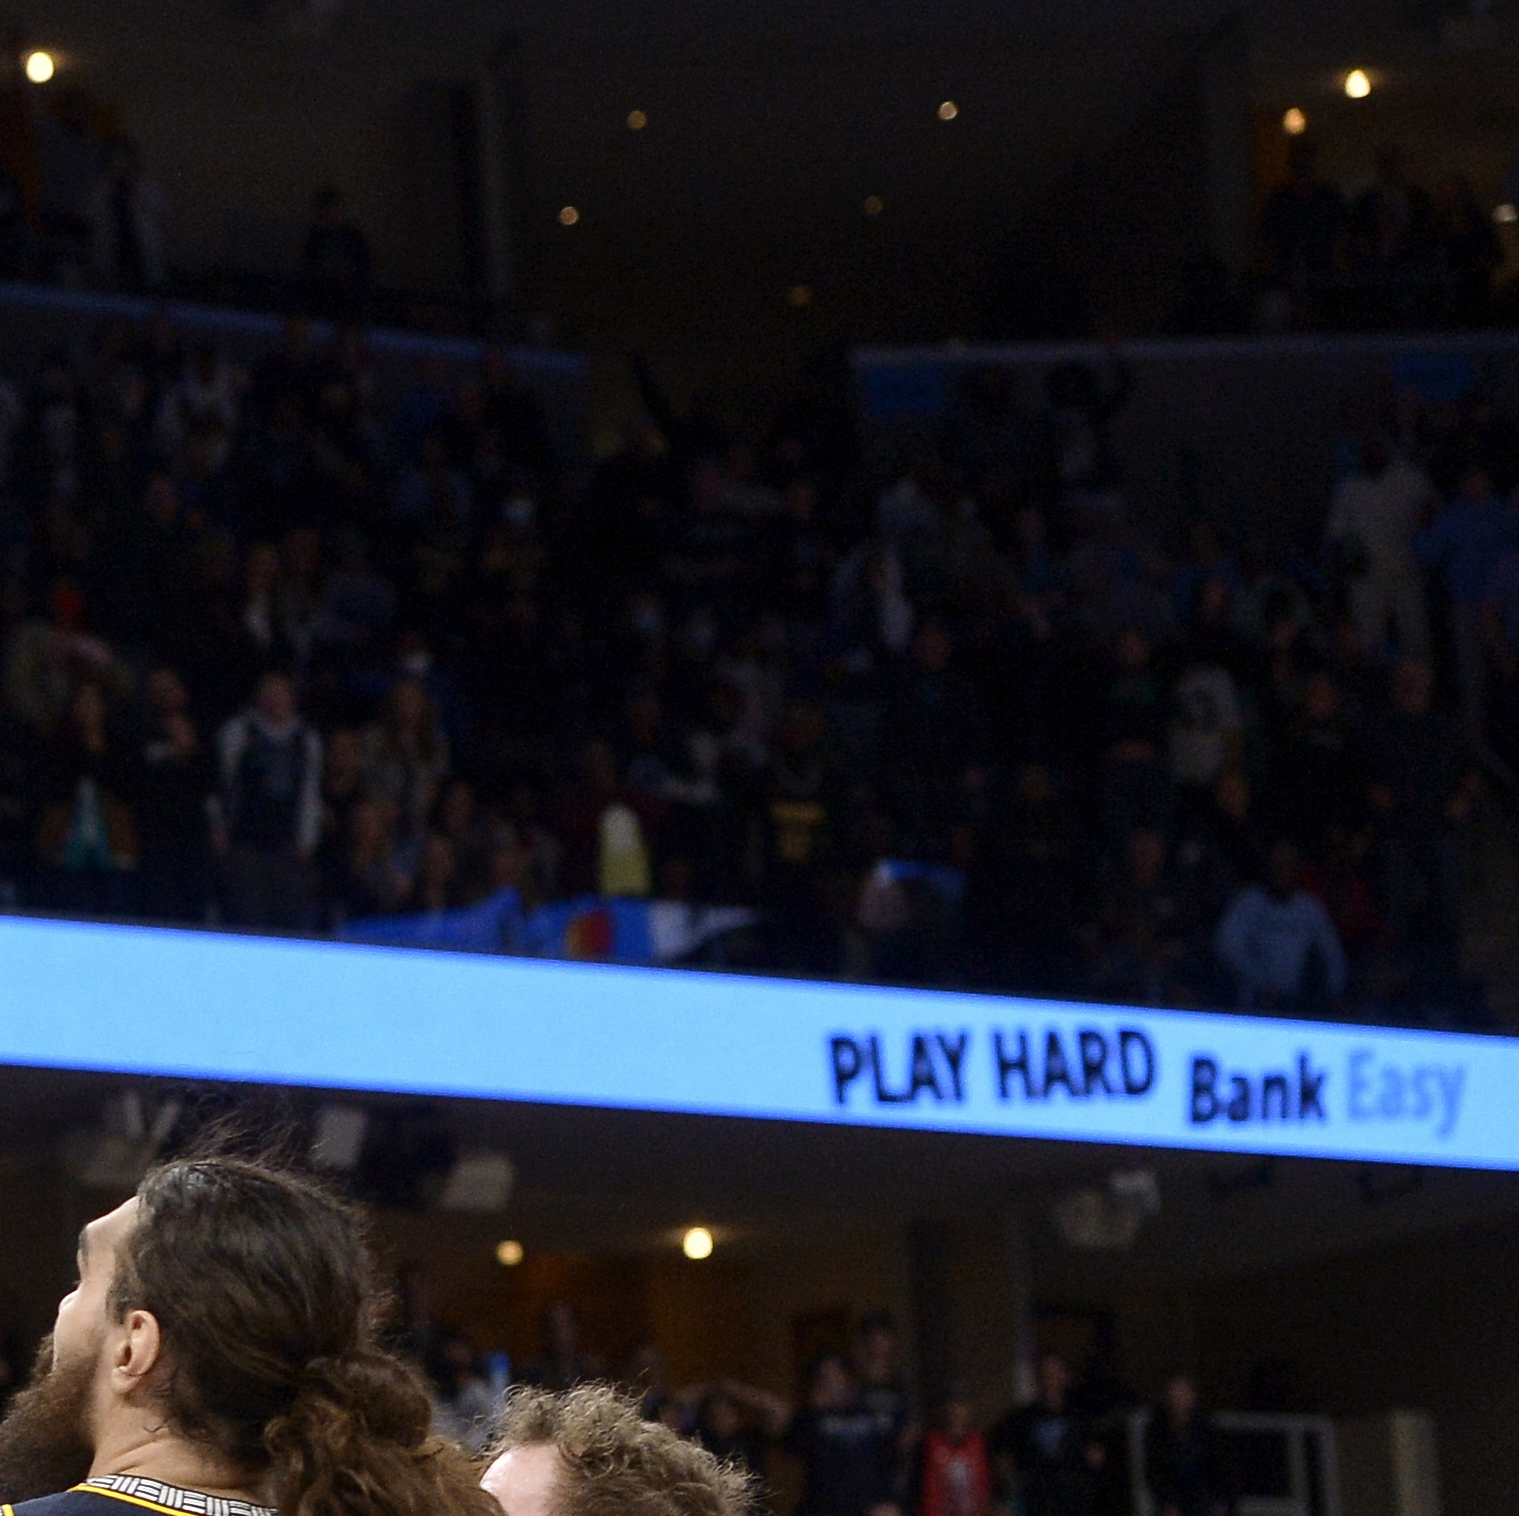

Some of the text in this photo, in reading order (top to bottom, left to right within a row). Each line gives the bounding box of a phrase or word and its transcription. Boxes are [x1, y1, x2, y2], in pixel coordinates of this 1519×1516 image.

[828, 1020, 1468, 1141] PLAY HARD Bank Easy
